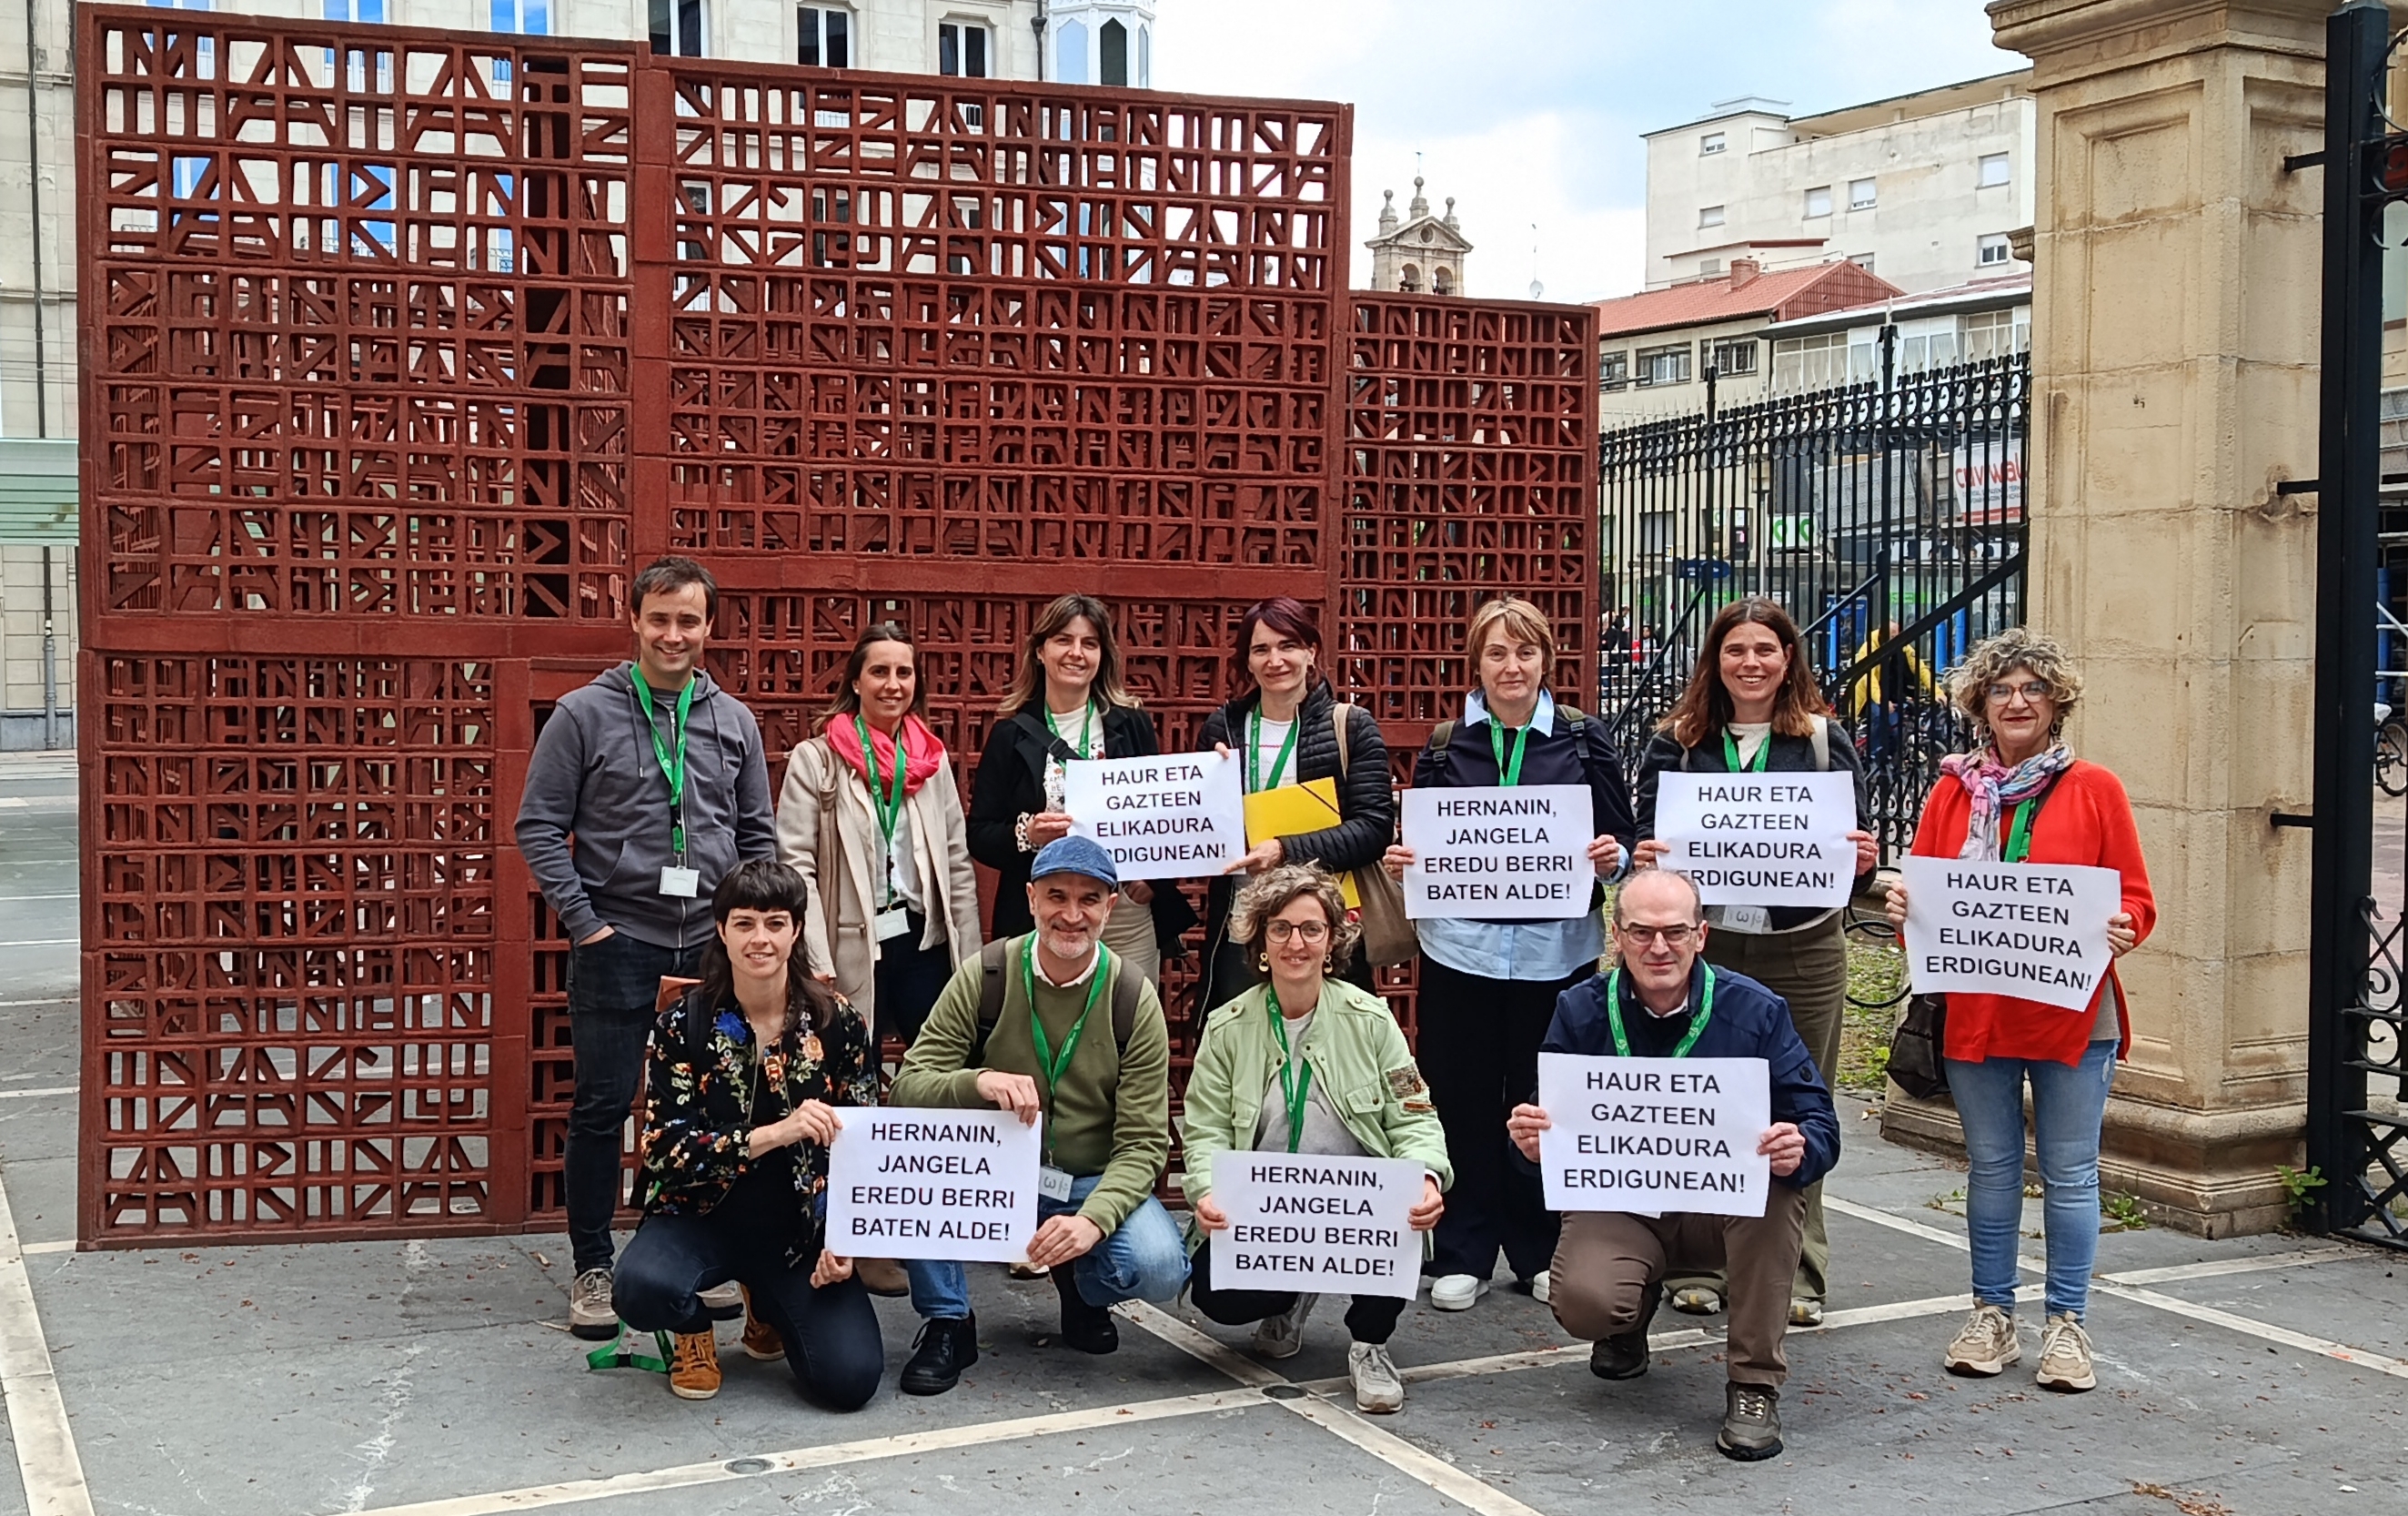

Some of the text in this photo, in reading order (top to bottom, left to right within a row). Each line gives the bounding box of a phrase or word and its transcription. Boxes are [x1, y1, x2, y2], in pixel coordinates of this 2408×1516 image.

[1102, 764, 1204, 785] HAUR ETA
[1106, 791, 1201, 810] GAZTEEN
[1698, 786, 1813, 803] HAUR ETA
[1437, 799, 1557, 817] HERNANIN,
[1096, 816, 1214, 837] ELIKADURA
[1701, 814, 1808, 830] GAZTEEN
[1446, 827, 1549, 845] JANGELA
[1106, 843, 1225, 864] DIGUNEAN!
[1688, 841, 1822, 860] ELIKADURA
[1425, 855, 1573, 874] EREDU BERRI
[1676, 868, 1834, 889] RDIGUNEAN!
[1947, 872, 2074, 896] HAUR ETA
[1426, 883, 1570, 900] BATEN ALDE!
[1951, 900, 2069, 925] GAZTEEN
[1939, 927, 2082, 958] ELIKADURA
[1926, 955, 2091, 990] ERDIGUNEAN!
[1587, 1071, 1720, 1094] HAUR ETA
[1591, 1103, 1715, 1127] GAZTEEN
[872, 1123, 1001, 1147] HERNANIN,
[1577, 1134, 1731, 1158] ELIKADURA
[878, 1155, 991, 1176] JANGELA
[1251, 1166, 1384, 1191] HERNANIN,
[1564, 1168, 1745, 1193] ERDIGUNEAN!
[851, 1186, 1014, 1208] EREDU BERRI
[1259, 1196, 1374, 1217] JANGELA
[851, 1218, 1010, 1241] BATEN ALDE!
[1234, 1225, 1398, 1248] EREDU BERRI
[1235, 1253, 1394, 1277] BATEN ALDE!
